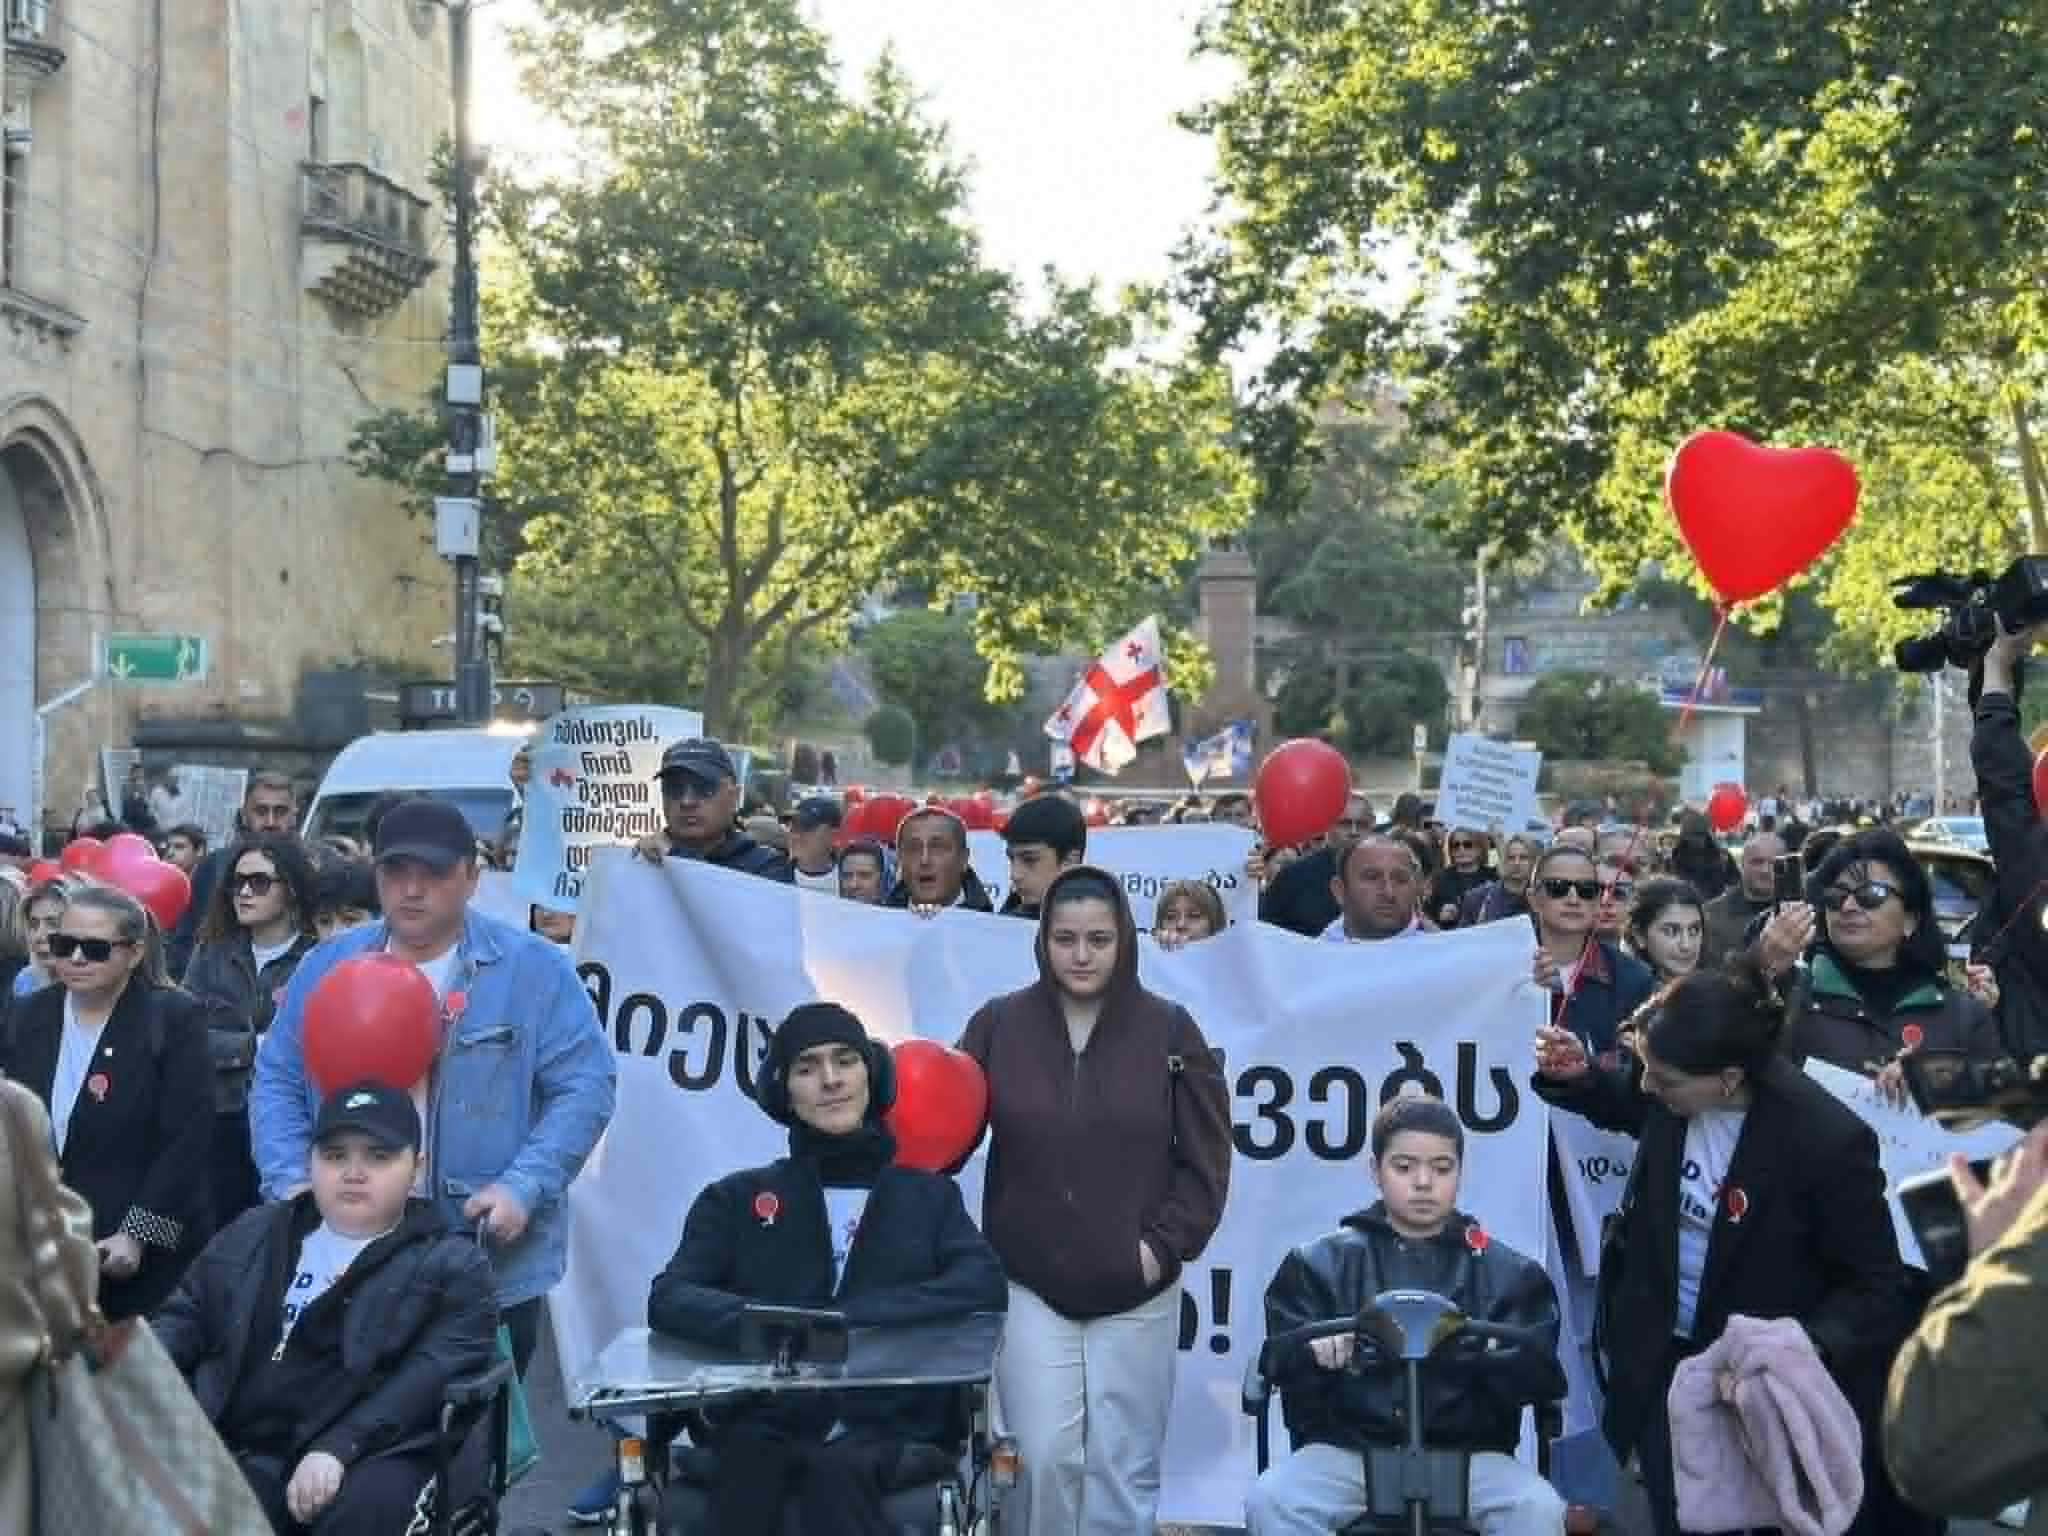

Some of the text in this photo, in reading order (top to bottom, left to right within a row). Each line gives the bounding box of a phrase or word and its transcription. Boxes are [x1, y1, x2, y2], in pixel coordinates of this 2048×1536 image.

[576, 778, 650, 809] შვილი
[580, 750, 633, 776] რომ
[576, 961, 774, 1100] მიეც
[1214, 1041, 1519, 1160] ვებს
